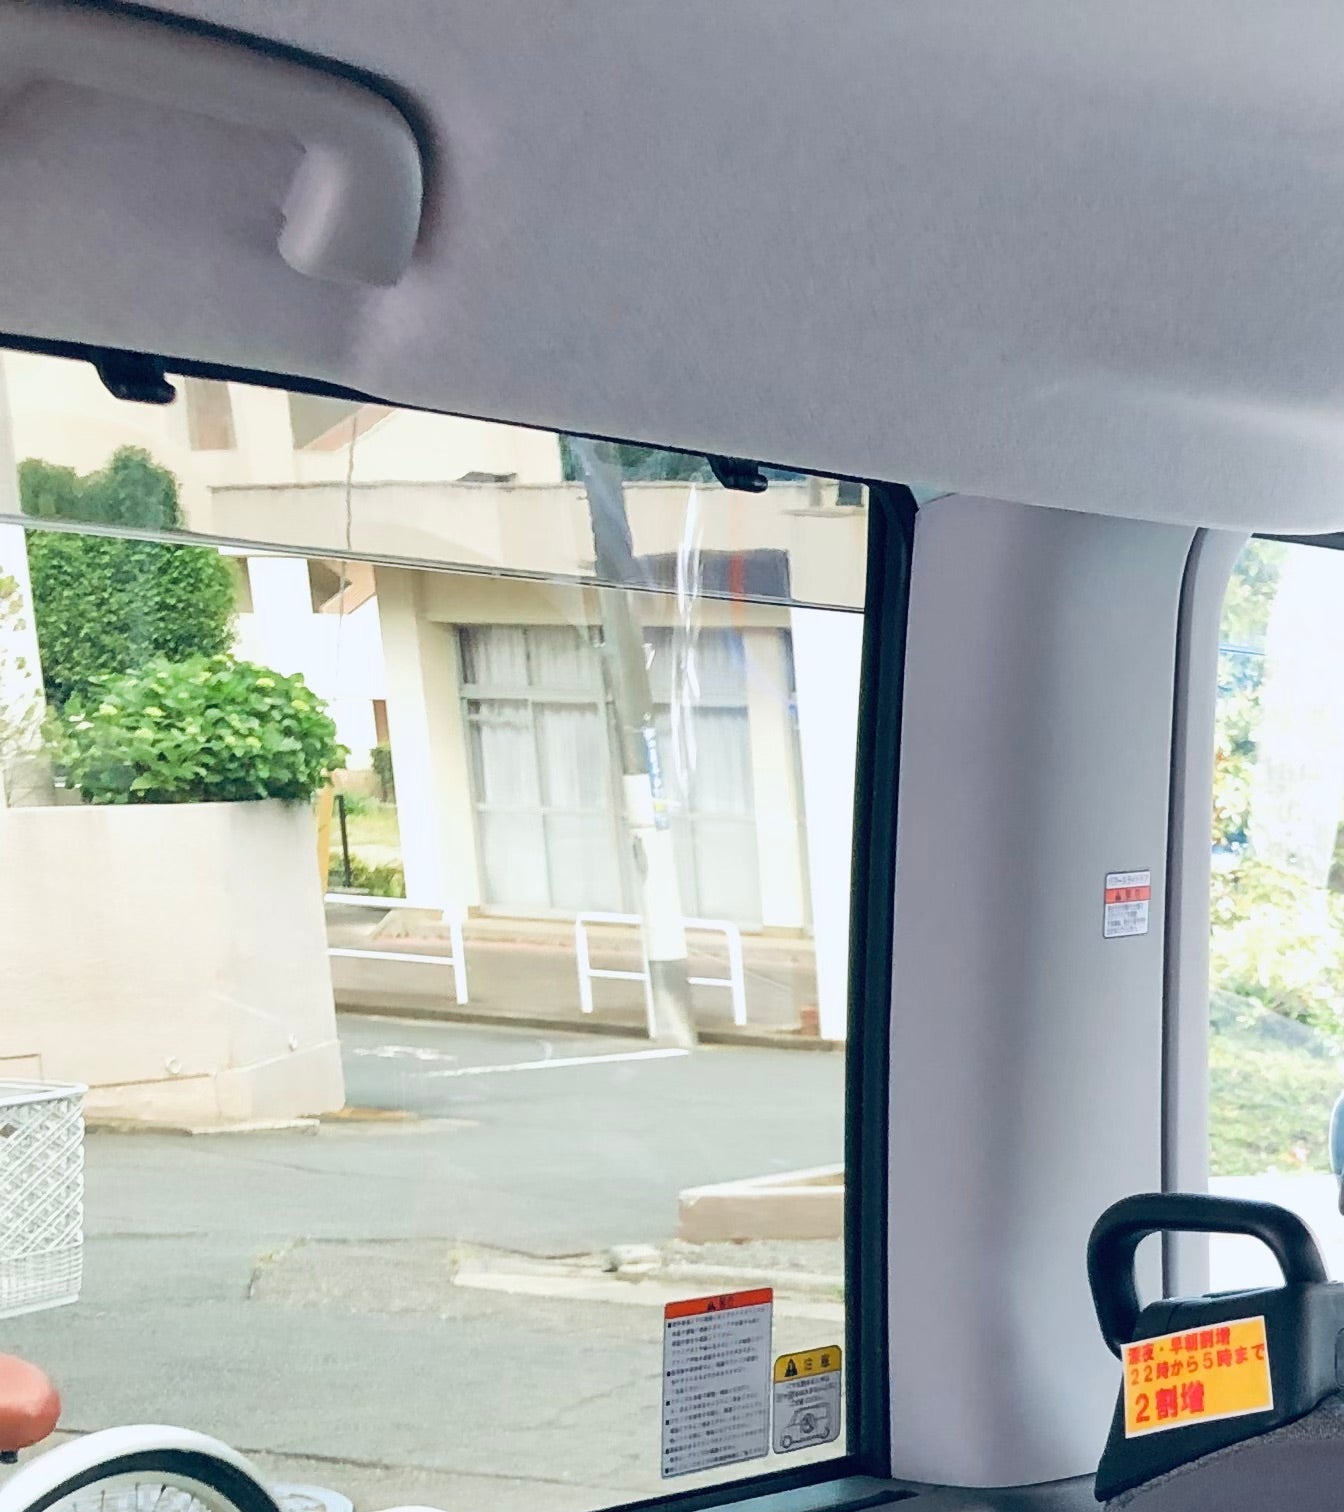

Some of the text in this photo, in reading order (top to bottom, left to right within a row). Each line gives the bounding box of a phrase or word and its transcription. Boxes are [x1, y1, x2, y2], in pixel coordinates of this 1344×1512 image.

[1128, 1327, 1231, 1365] 深夜・早朝割増
[1131, 1343, 1265, 1386] 22時から5時まで
[1135, 1380, 1205, 1423] 2割増
